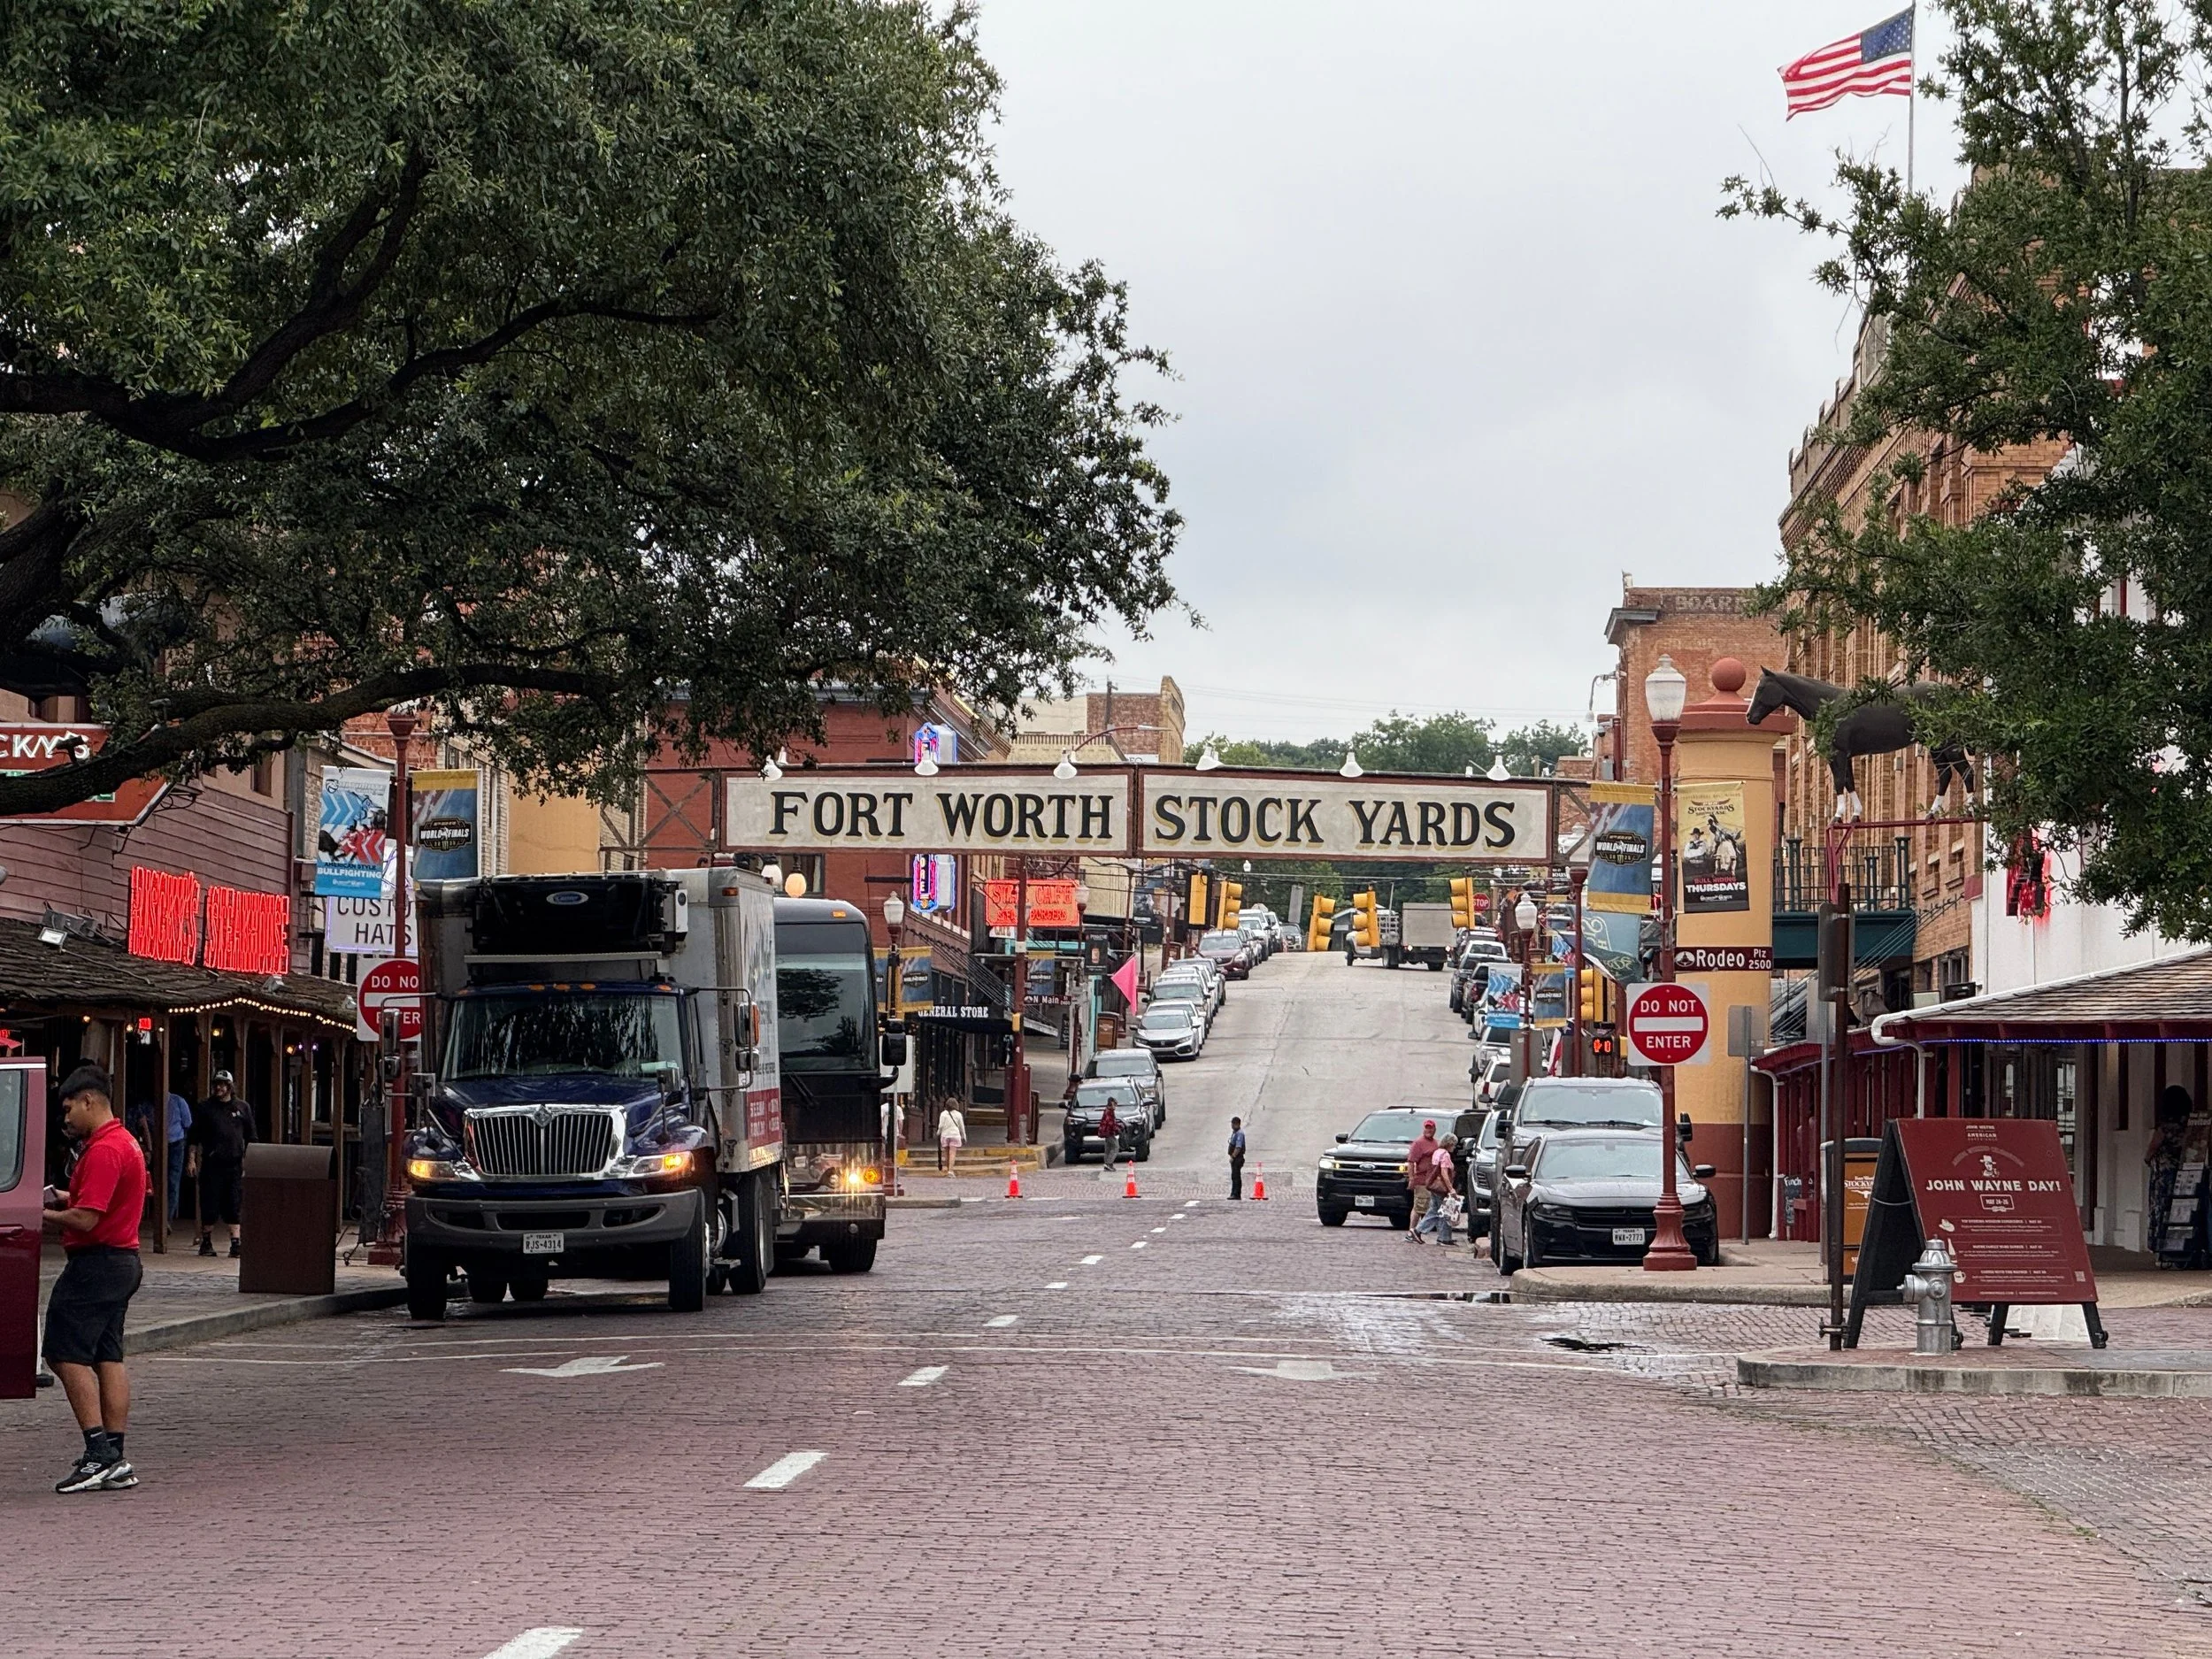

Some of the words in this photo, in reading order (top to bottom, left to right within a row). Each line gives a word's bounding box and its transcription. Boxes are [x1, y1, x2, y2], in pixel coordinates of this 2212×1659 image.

[769, 791, 913, 838] FORT
[936, 793, 1113, 840] WORTH
[1155, 795, 1325, 844] STOCK
[1348, 800, 1516, 849] YARDS
[420, 830, 442, 840] WORLD
[448, 828, 470, 838] FINALS
[1596, 841, 1617, 852] WORLD
[1623, 842, 1645, 854] FINALS
[317, 867, 383, 879] BULLFIGHTING
[1686, 881, 1747, 894] THURSDAYS
[1472, 898, 1489, 907] STOP
[1696, 949, 1745, 967] Rodeo
[1753, 949, 1767, 958] Plz
[1748, 959, 1771, 970] 2500
[371, 975, 391, 987] DO
[399, 975, 419, 988] NO
[1041, 995, 1059, 1004] Main
[1640, 1000, 1660, 1013] DO
[1668, 999, 1697, 1013] NOT
[918, 1006, 957, 1018] GENERAL
[960, 1006, 989, 1018] STORE
[1646, 1035, 1692, 1048] ENTER
[1926, 1179, 1965, 1191] JOHN
[1970, 1179, 2023, 1191] WAYNE
[2028, 1180, 2062, 1192] DAY!
